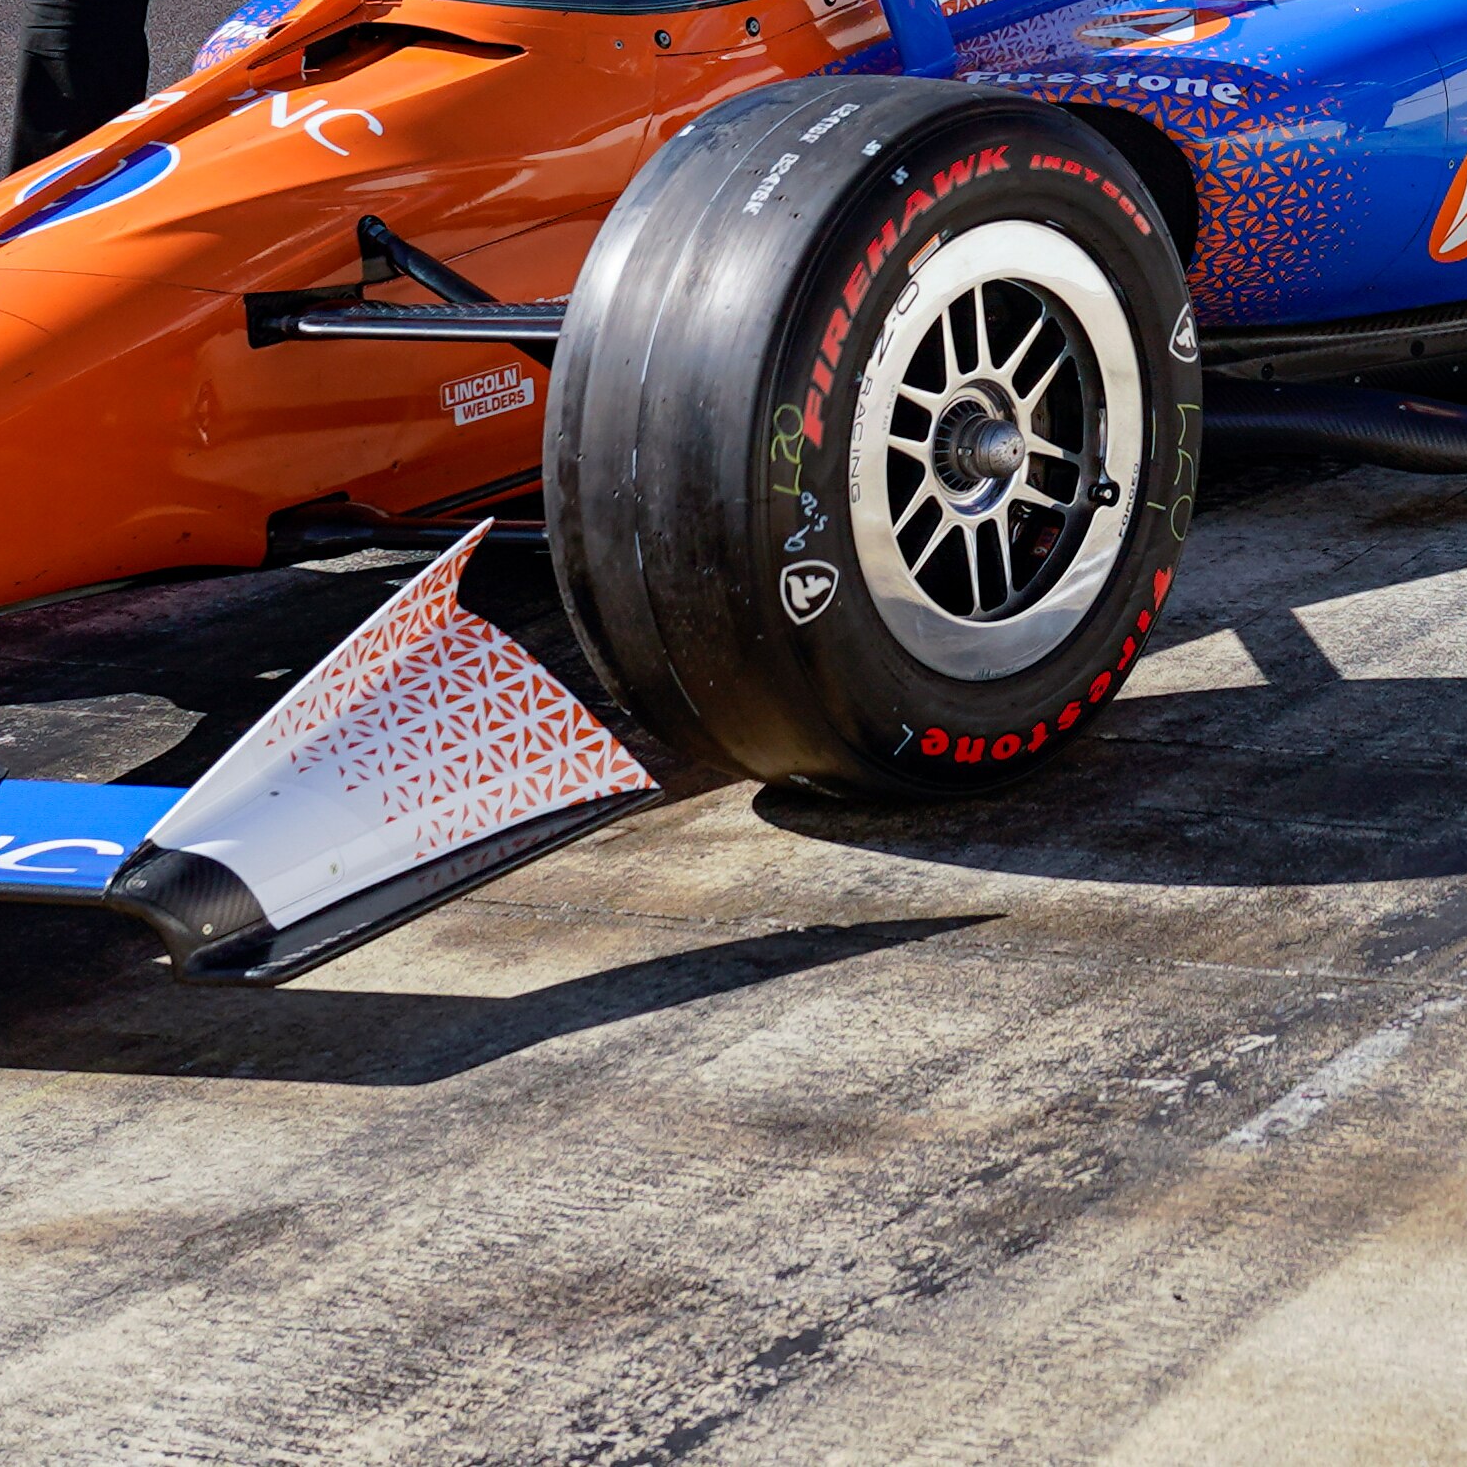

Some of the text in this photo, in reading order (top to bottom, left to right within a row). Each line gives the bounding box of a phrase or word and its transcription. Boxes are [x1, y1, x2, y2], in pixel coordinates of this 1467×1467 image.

[963, 69, 1245, 103] Firestone
[803, 143, 1010, 450] FIREHAWK
[1031, 154, 1101, 184] INDY
[1100, 179, 1153, 236] 500
[444, 367, 518, 406] LINCOLN
[462, 389, 526, 420] WELDERS
[850, 375, 874, 504] RACING
[1117, 462, 1140, 539] FORGED
[920, 564, 1174, 765] Firestone
